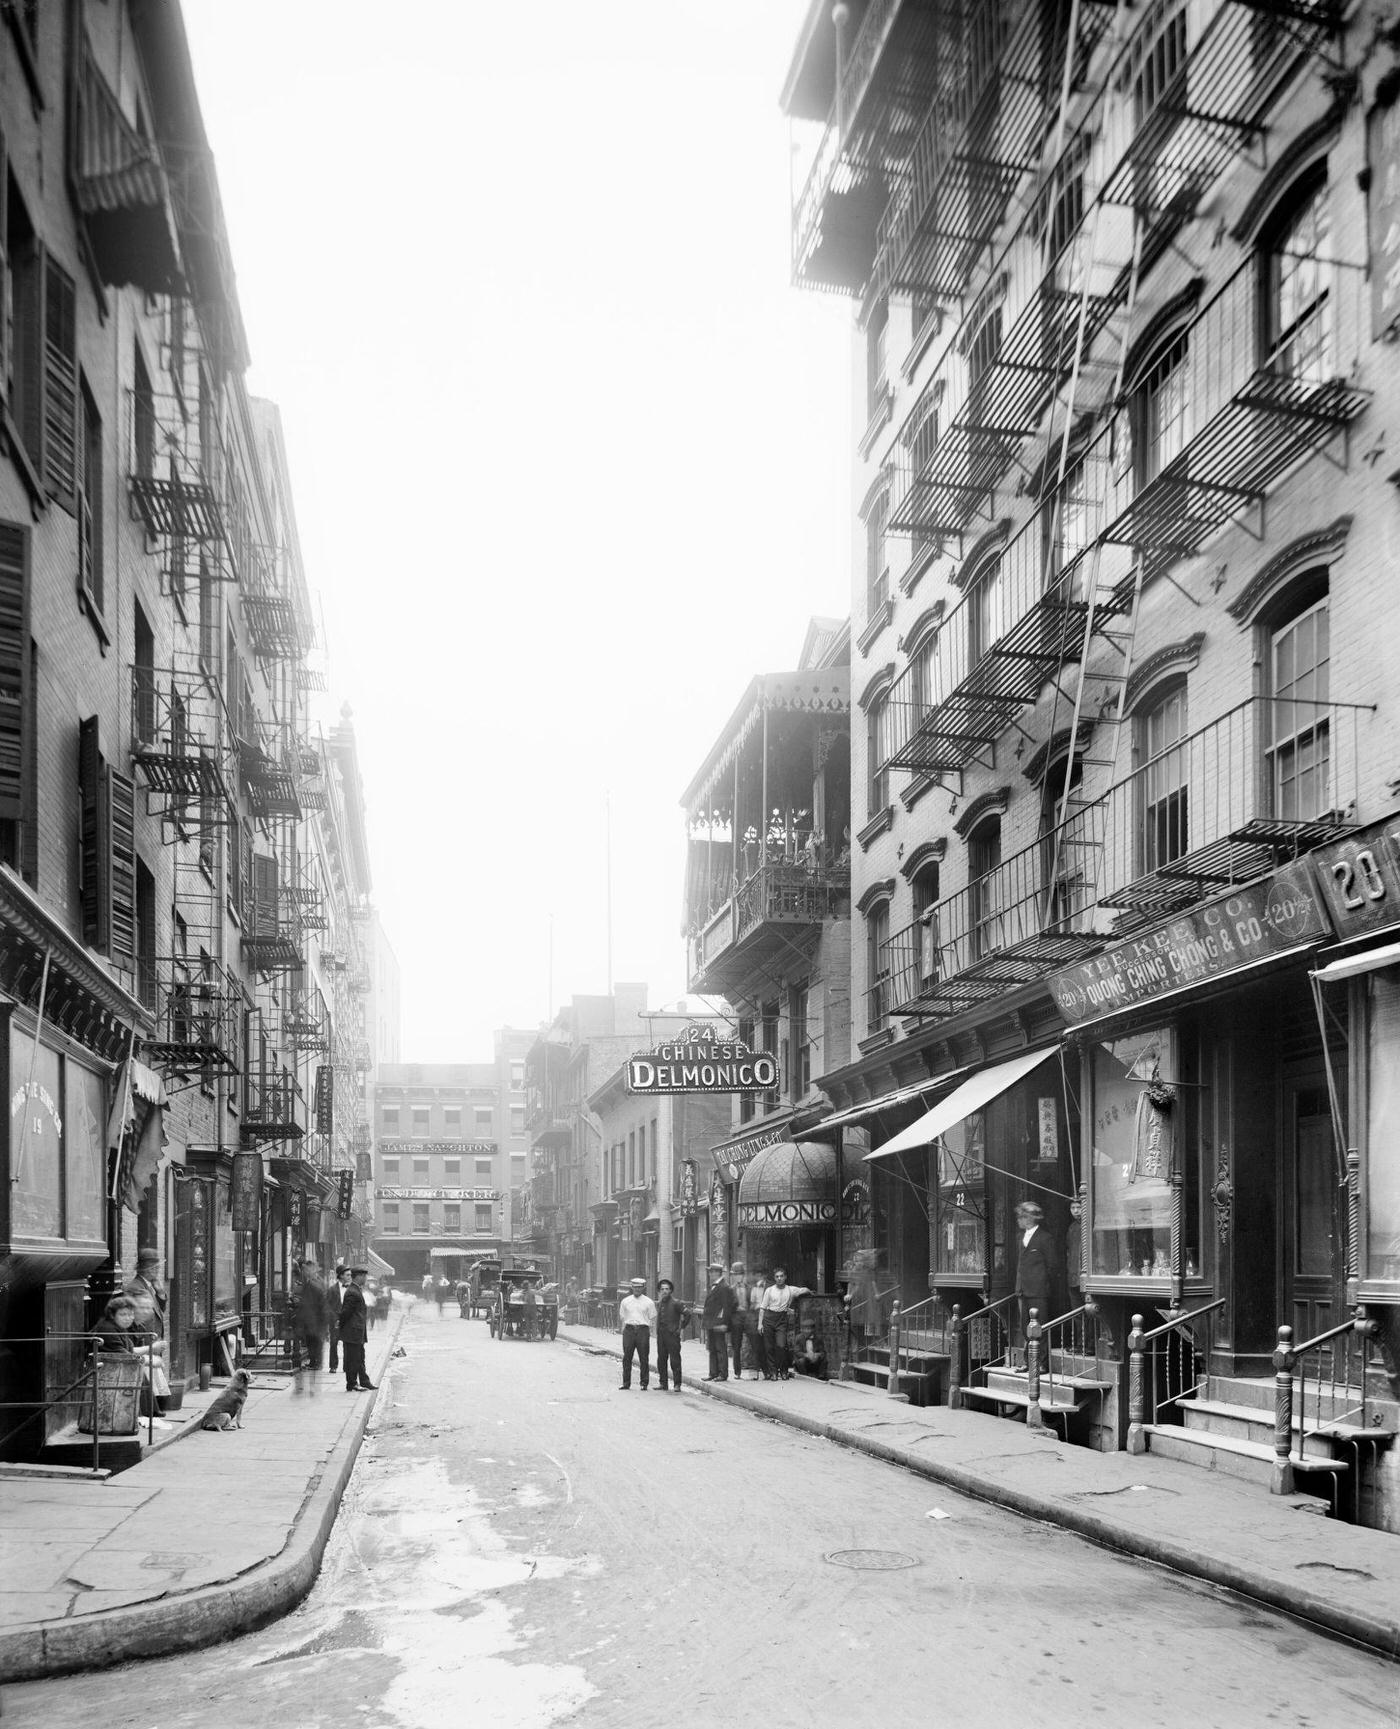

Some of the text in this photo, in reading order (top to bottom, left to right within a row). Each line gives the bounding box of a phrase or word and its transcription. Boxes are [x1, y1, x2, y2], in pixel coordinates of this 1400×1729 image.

[1332, 851, 1385, 909] 20
[1081, 898, 1252, 978] YEE KEE CO.
[1086, 917, 1269, 1006] QUONG CHING CHONG & CO.
[1117, 943, 1176, 972] SUCCESSORS
[690, 1028, 713, 1043] 24
[662, 1045, 744, 1061] CHINESE
[633, 1058, 775, 1087] DELMONICO
[956, 1193, 965, 1206] 22
